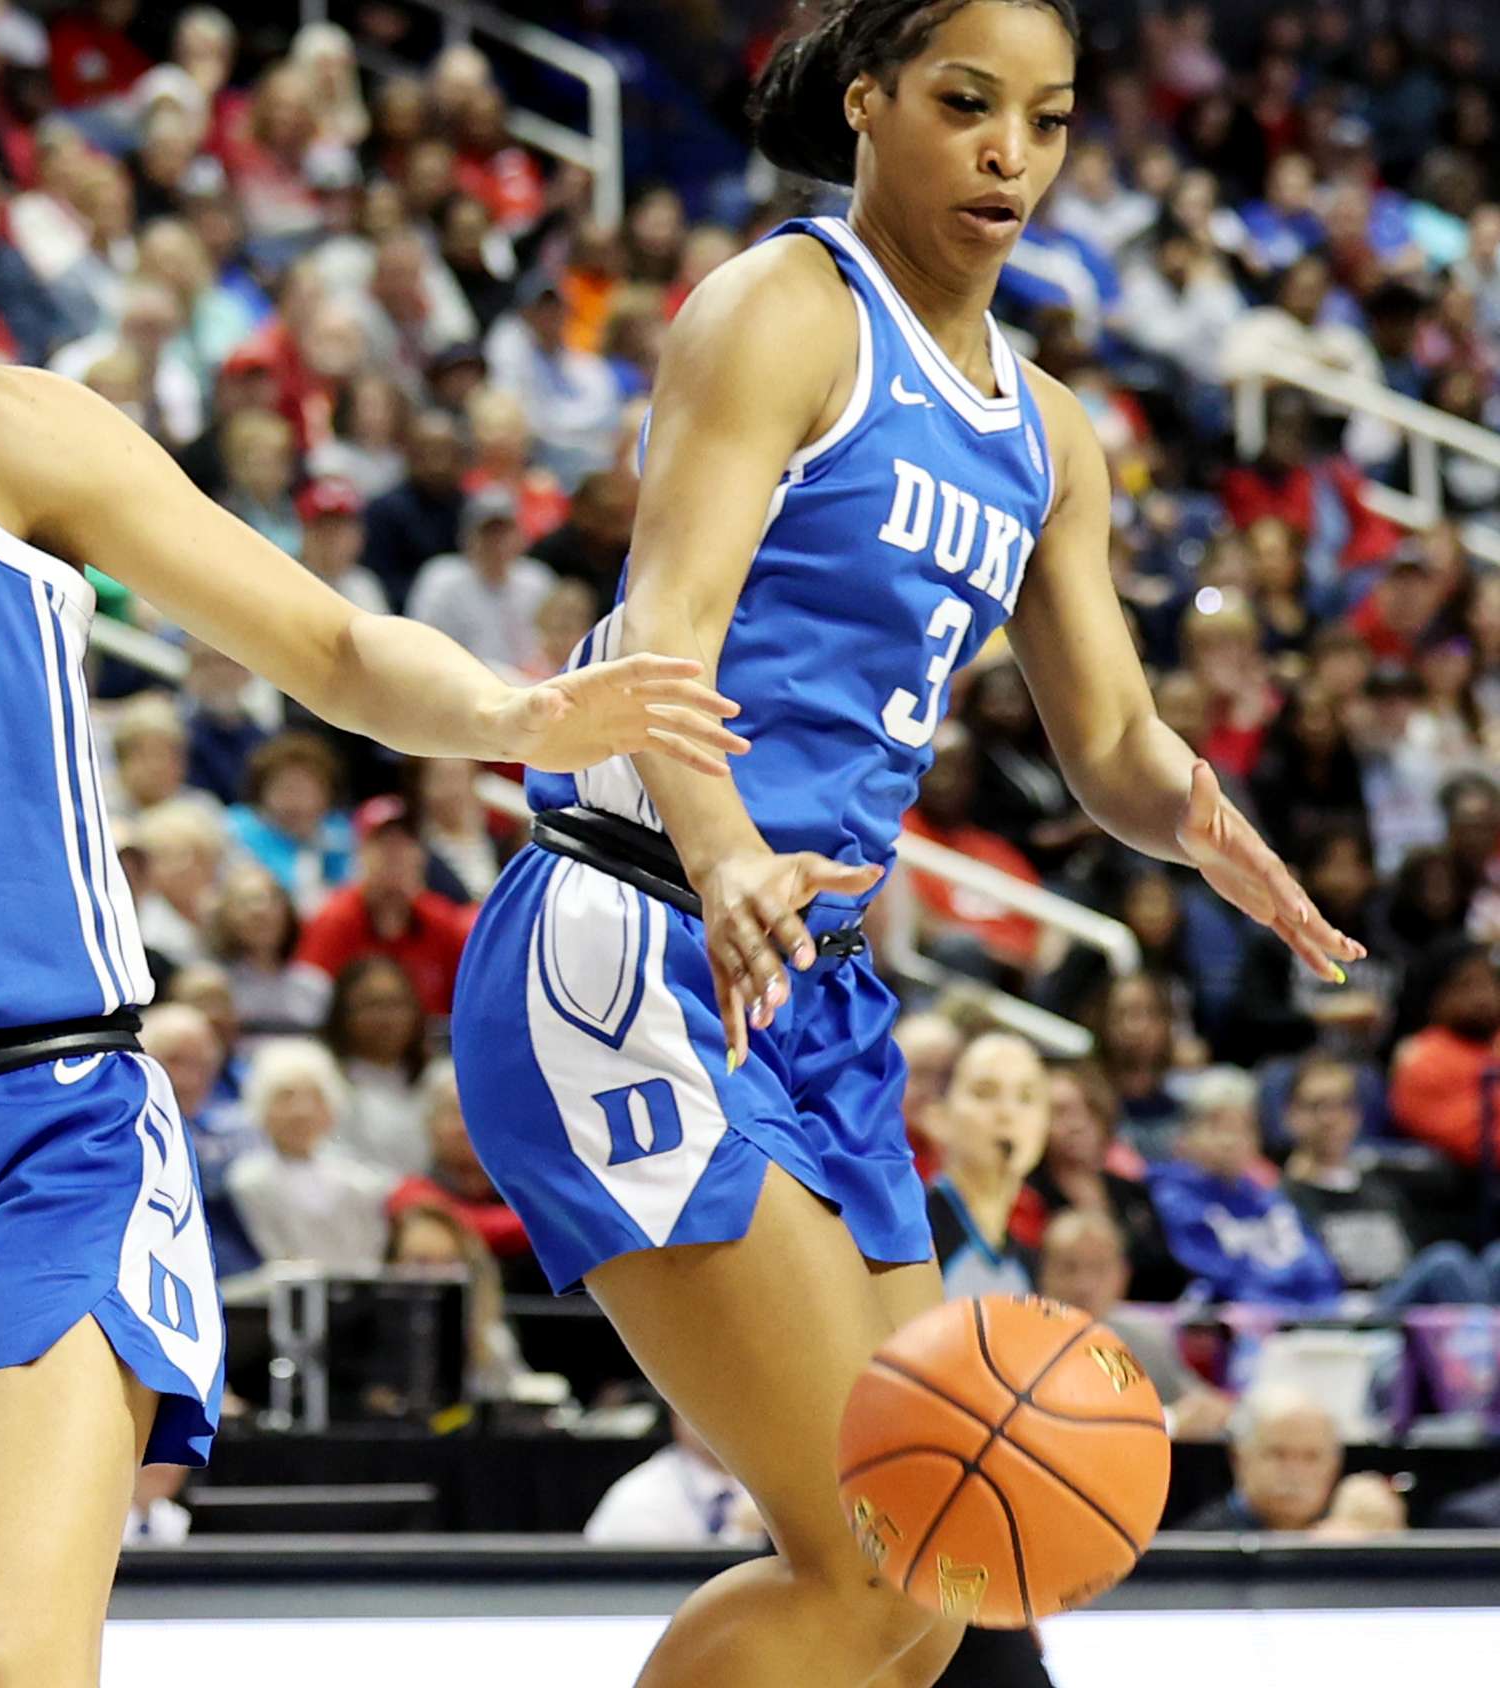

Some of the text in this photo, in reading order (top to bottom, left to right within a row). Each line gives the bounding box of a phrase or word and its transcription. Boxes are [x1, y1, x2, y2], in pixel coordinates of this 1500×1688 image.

[881, 596, 973, 749] 3
[590, 1077, 684, 1166] D
[147, 1249, 199, 1343] D
